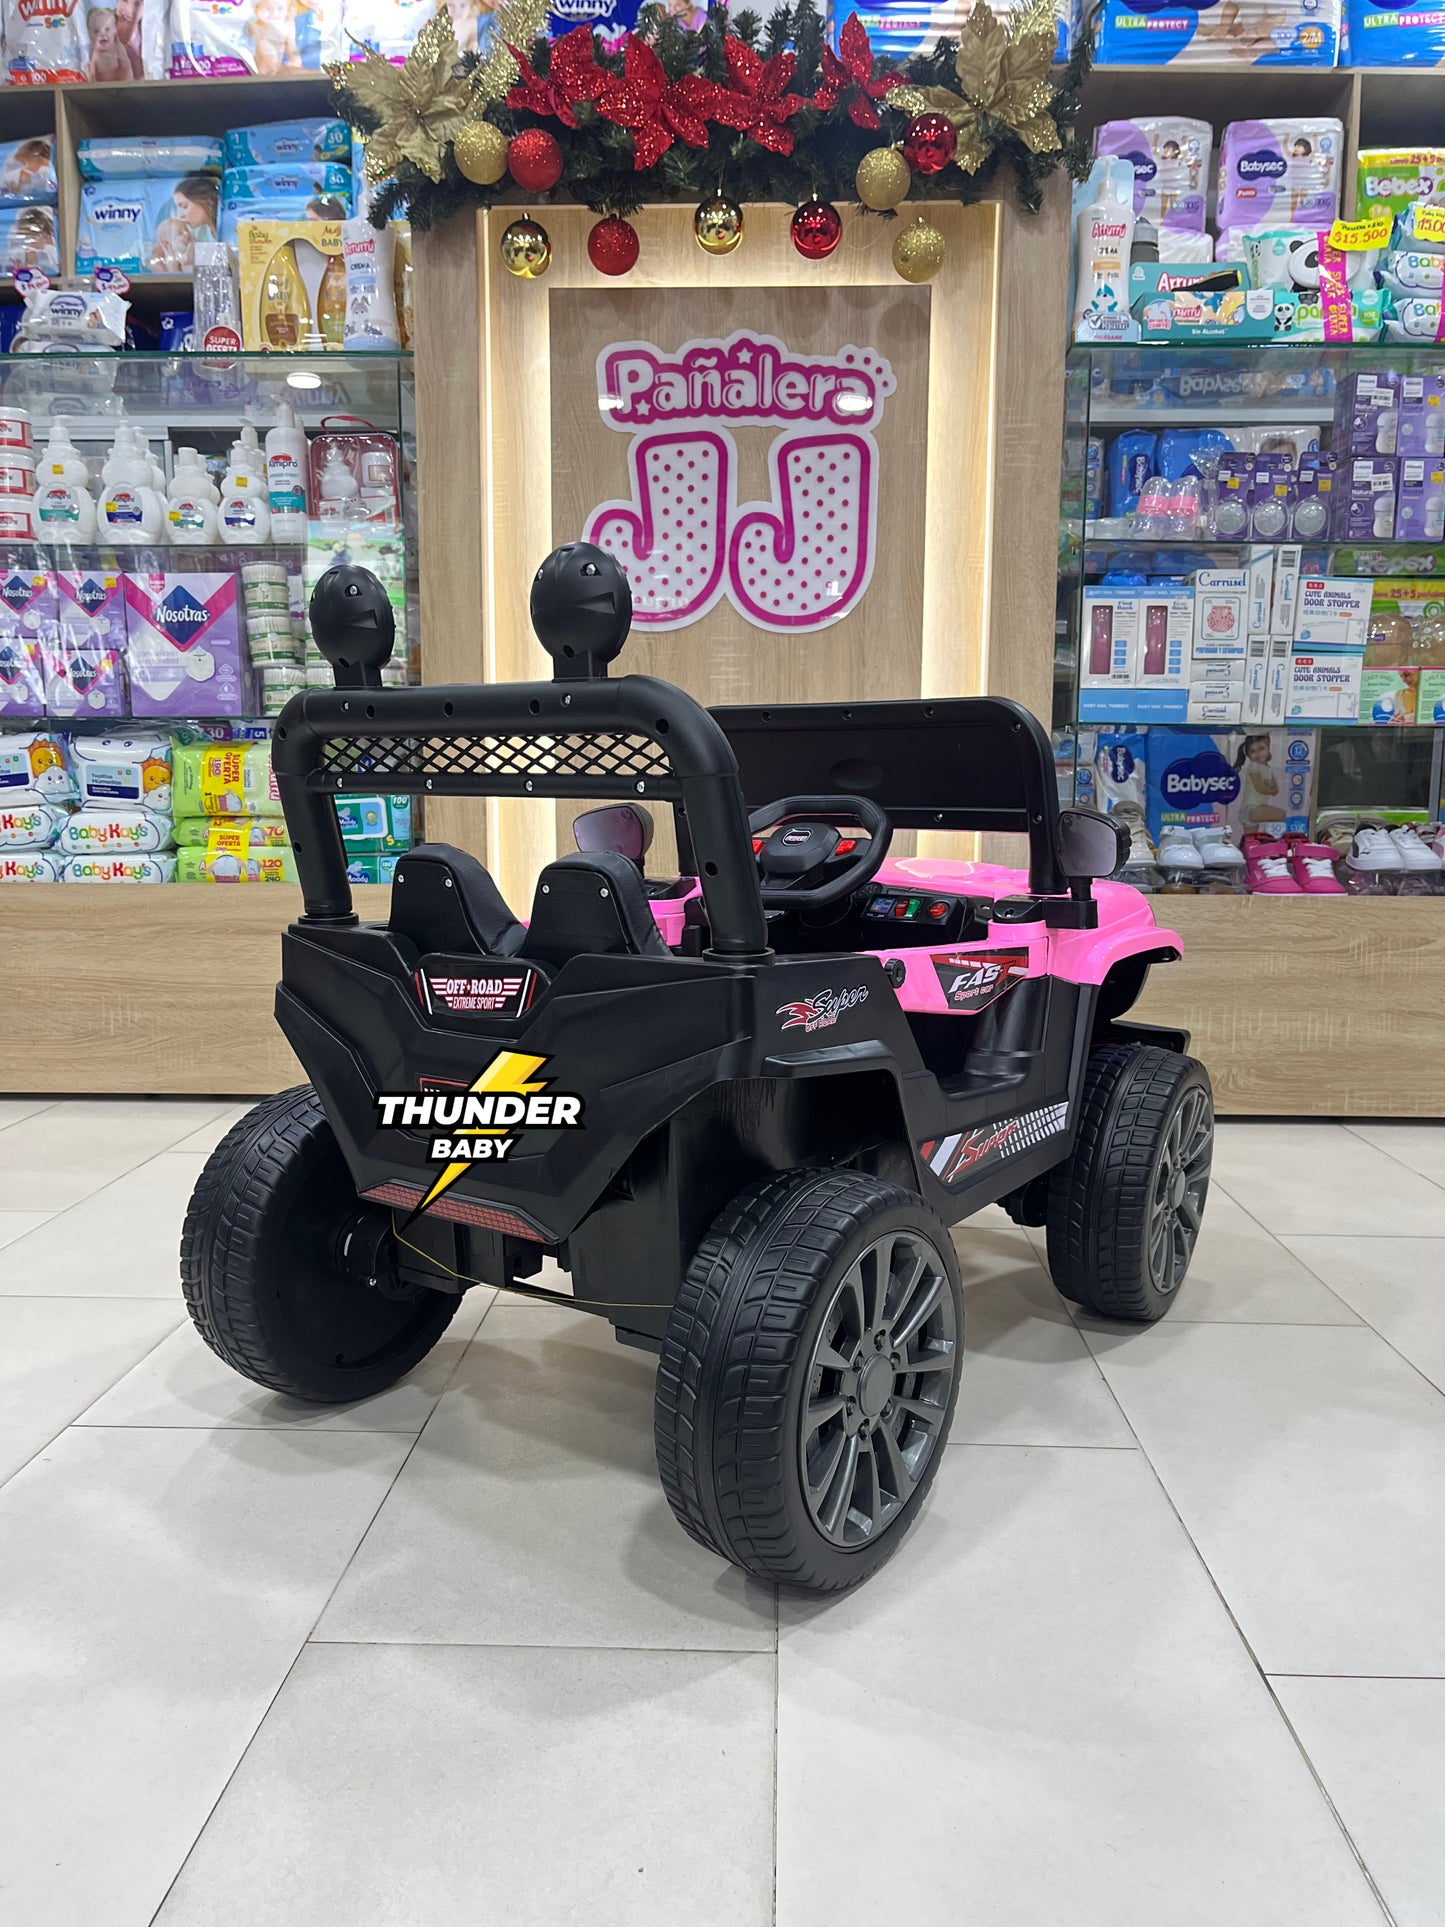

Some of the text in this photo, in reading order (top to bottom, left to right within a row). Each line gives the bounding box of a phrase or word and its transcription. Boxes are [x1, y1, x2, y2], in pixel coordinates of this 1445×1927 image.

[1116, 16, 1188, 30] ULTRA PROTECT
[1364, 14, 1398, 28] ULTRA
[1240, 160, 1285, 174] Babysec
[1365, 176, 1432, 197] Bebex
[94, 204, 141, 222] winny
[51, 305, 82, 318] winny
[209, 337, 236, 345] SUPER
[612, 351, 874, 416] Pañalera
[1198, 571, 1246, 587] Carrusel
[2, 588, 33, 598] Nosotras
[1304, 590, 1351, 599] CUTE ANIMALS
[1303, 599, 1360, 609] DOOR STOPPER
[157, 604, 208, 623] Nosotras
[1294, 666, 1341, 675] CUTE ANIMALS
[1293, 674, 1350, 683] DOOR STOPPER
[1166, 773, 1235, 795] Babysec
[3, 813, 42, 831] Kay's
[1161, 813, 1220, 823] ULTRA PROTECT
[69, 823, 148, 843] Baby Kay's
[5, 861, 45, 879] Kay's
[262, 859, 282, 868] 120
[72, 862, 151, 880] Baby Kay's
[947, 960, 1017, 994] FAST
[446, 979, 503, 995] OFF ROAD
[954, 987, 979, 1001] Sport
[452, 996, 495, 1010] EXTREME SPORT
[806, 986, 869, 1023] Super
